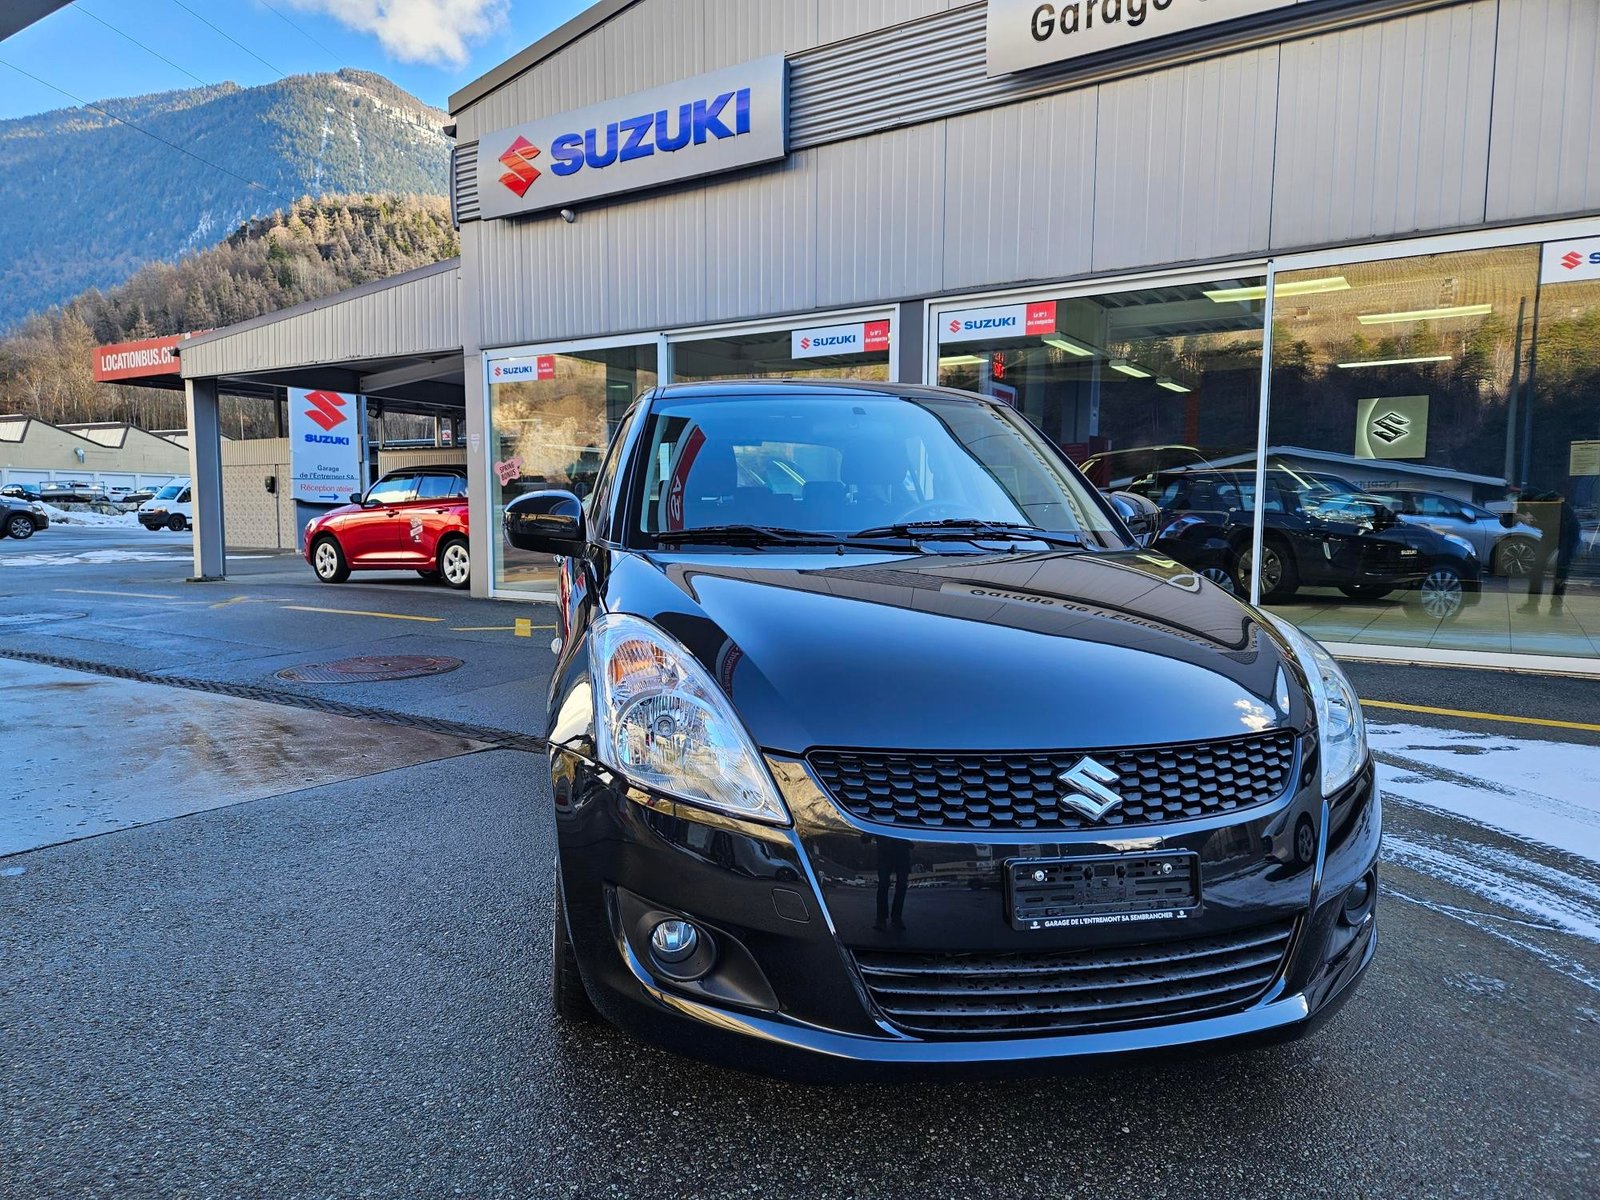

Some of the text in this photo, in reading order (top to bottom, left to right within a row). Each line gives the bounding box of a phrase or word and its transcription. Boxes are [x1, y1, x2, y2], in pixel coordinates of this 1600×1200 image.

[550, 88, 750, 176] SUZUKI
[964, 317, 1015, 330] SUZUKI
[813, 335, 856, 347] SUZUKI
[503, 366, 532, 375] SUZUKI
[304, 434, 349, 445] SUZUKI
[317, 464, 339, 473] Garage
[499, 462, 515, 473] SPRING
[501, 469, 517, 481] BONUS
[300, 483, 335, 493] Réception
[1044, 918, 1070, 928] GARAGE
[1070, 918, 1080, 926] DE
[1080, 915, 1121, 925] L'ENTREMONT
[1121, 914, 1130, 922] SA
[1130, 912, 1174, 921] SEMBRANCHER
